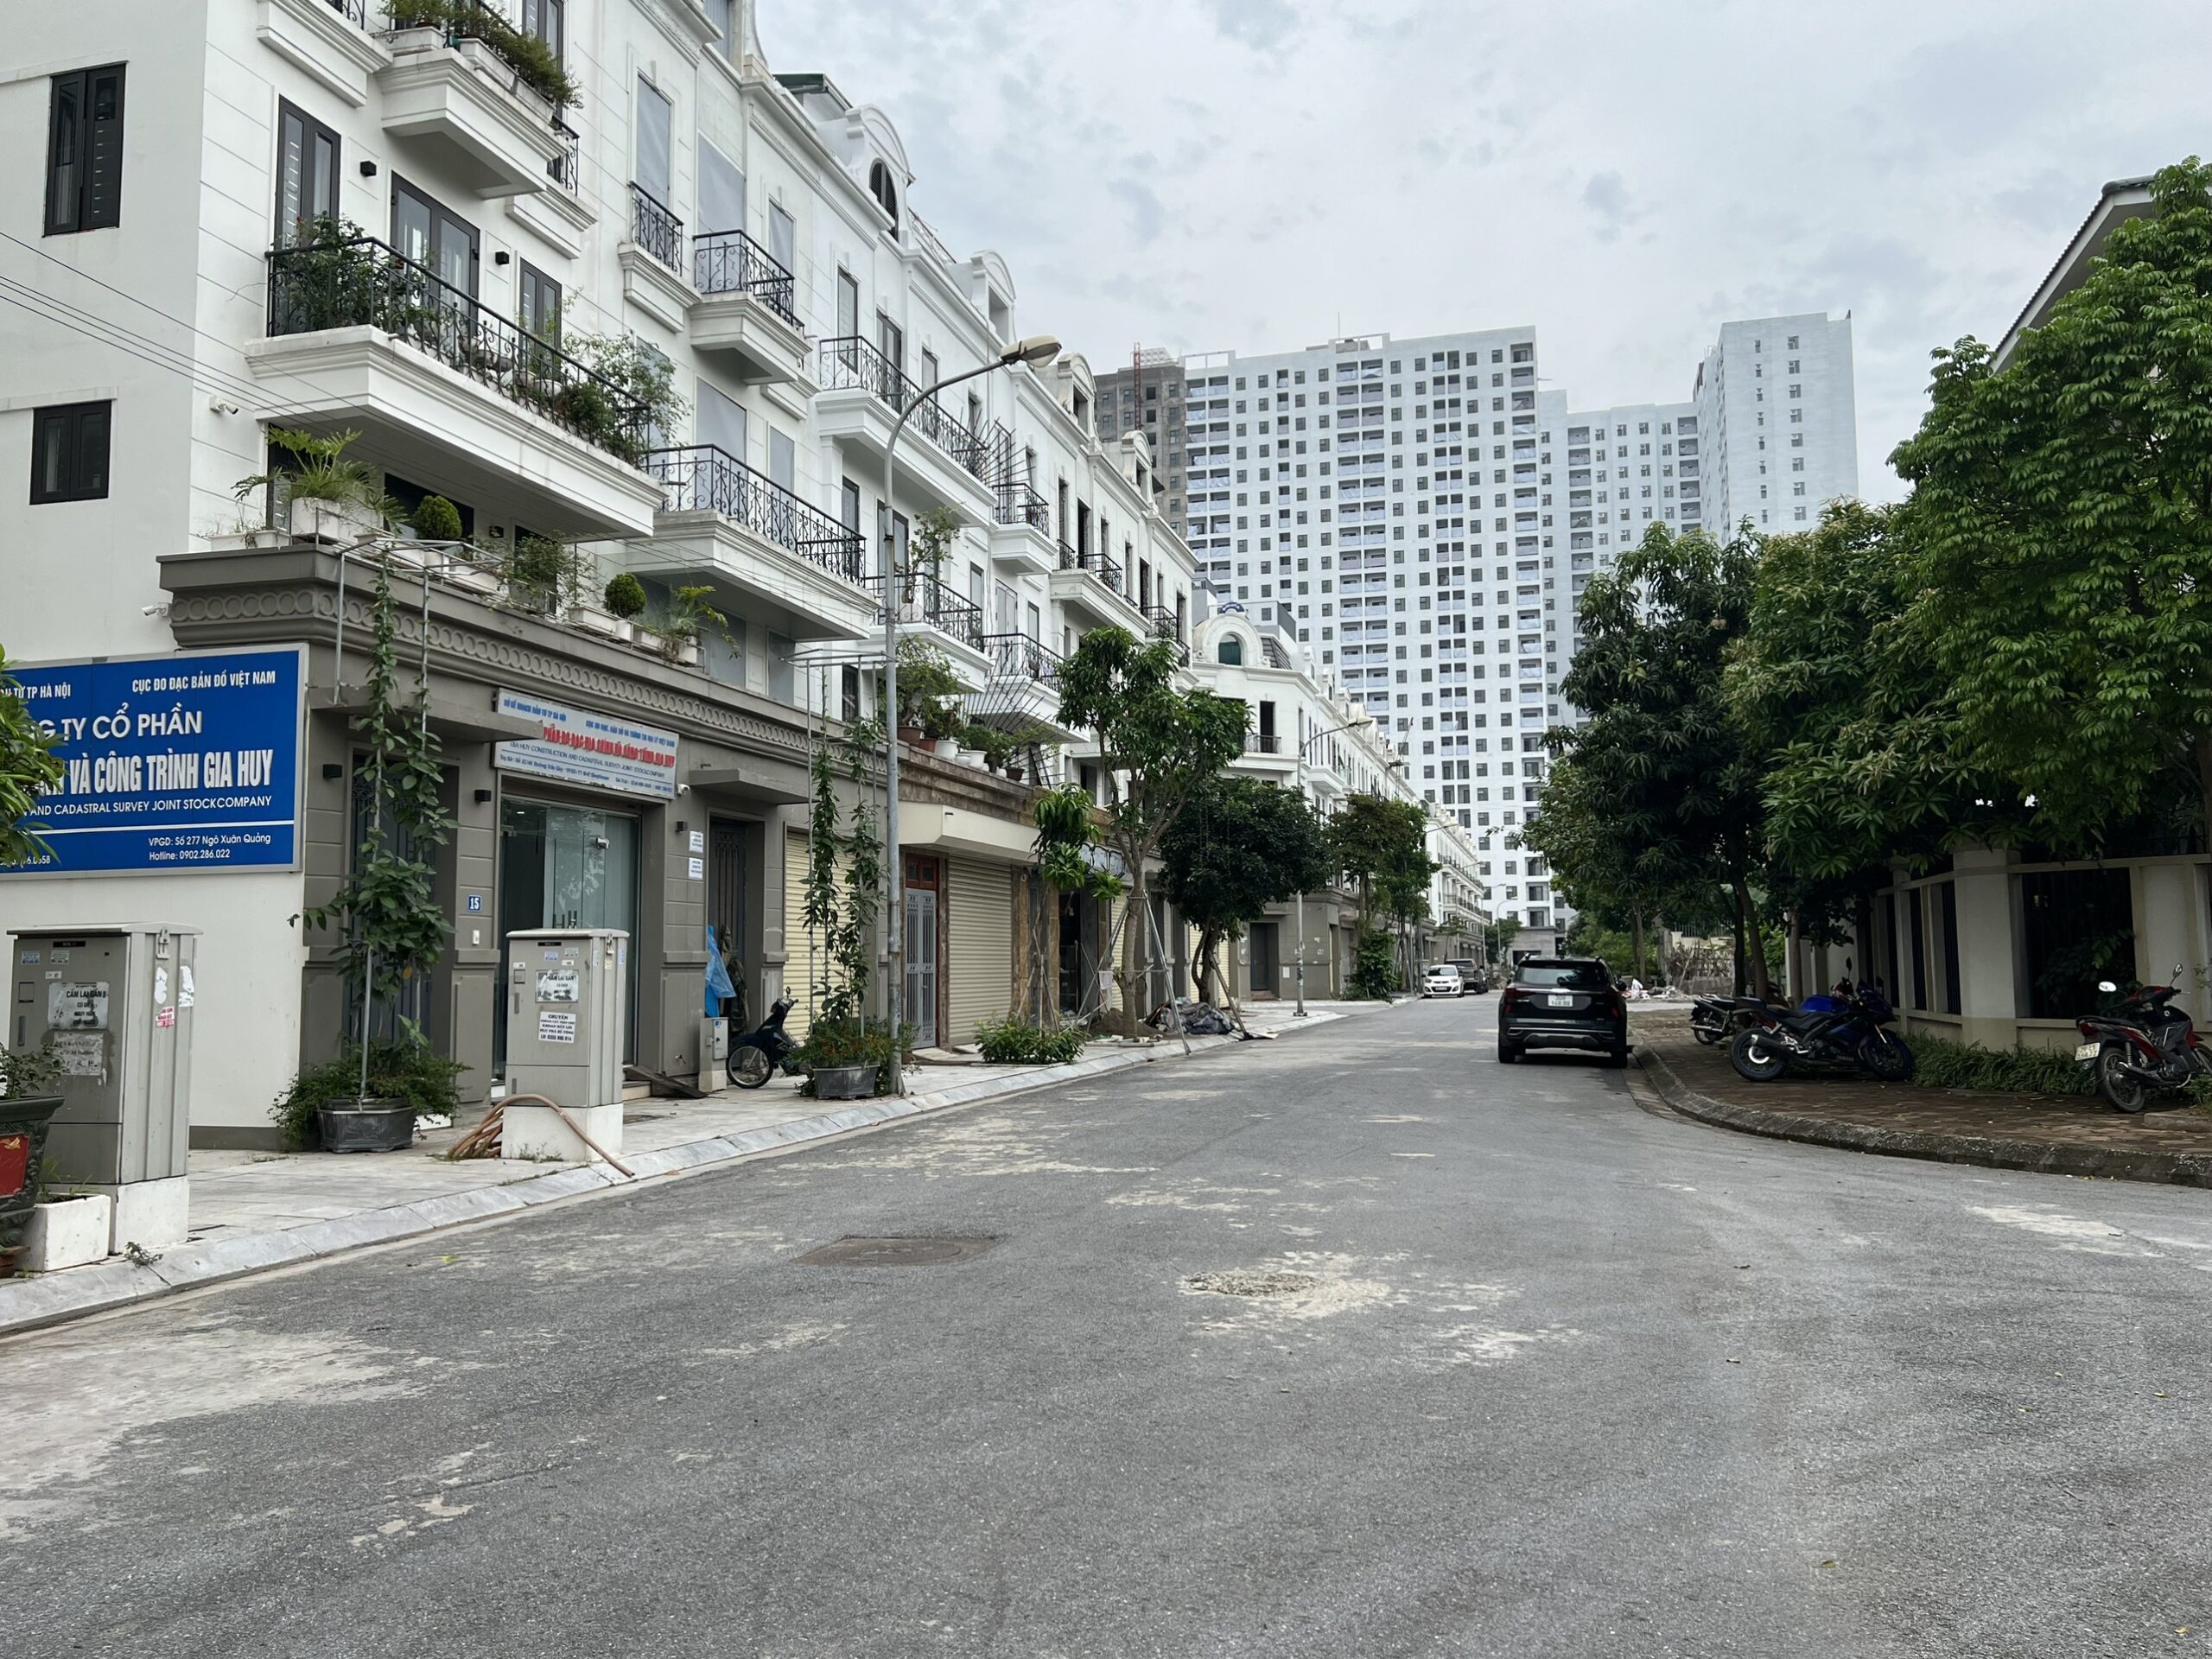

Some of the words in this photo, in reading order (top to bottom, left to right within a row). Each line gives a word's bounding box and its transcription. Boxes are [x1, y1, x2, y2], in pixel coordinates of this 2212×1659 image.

[27, 686, 38, 699] TP
[40, 683, 52, 698] HÀ
[54, 681, 71, 699] NỘI
[132, 678, 151, 695] CỤC
[154, 677, 167, 691] ĐO
[169, 676, 188, 692] ĐẠC
[191, 671, 211, 689] BẢN
[213, 669, 227, 688] ĐỒ
[230, 670, 251, 688] VIỆT
[252, 671, 276, 685] NAM
[60, 717, 87, 741] TY
[92, 702, 130, 740] CỔ
[137, 702, 202, 737] PHẦN
[69, 752, 92, 794] VÀ
[94, 750, 143, 793] CÔNG
[146, 747, 200, 791] TRÌNH
[204, 750, 233, 789] GIA
[237, 749, 274, 787] HUY
[30, 805, 52, 817] AND
[54, 803, 111, 816] CADASTRAL
[112, 801, 149, 812] SURVEY
[152, 799, 181, 810] JOINT
[149, 837, 173, 847] VPGD:
[175, 836, 185, 845] Số
[187, 836, 200, 845] 277
[202, 835, 219, 847] Ngô
[220, 835, 241, 844] Xuân
[243, 832, 271, 844] Quảng
[149, 851, 178, 861] Hotline:
[179, 849, 231, 860] 0902.286.022
[469, 897, 480, 909] 15
